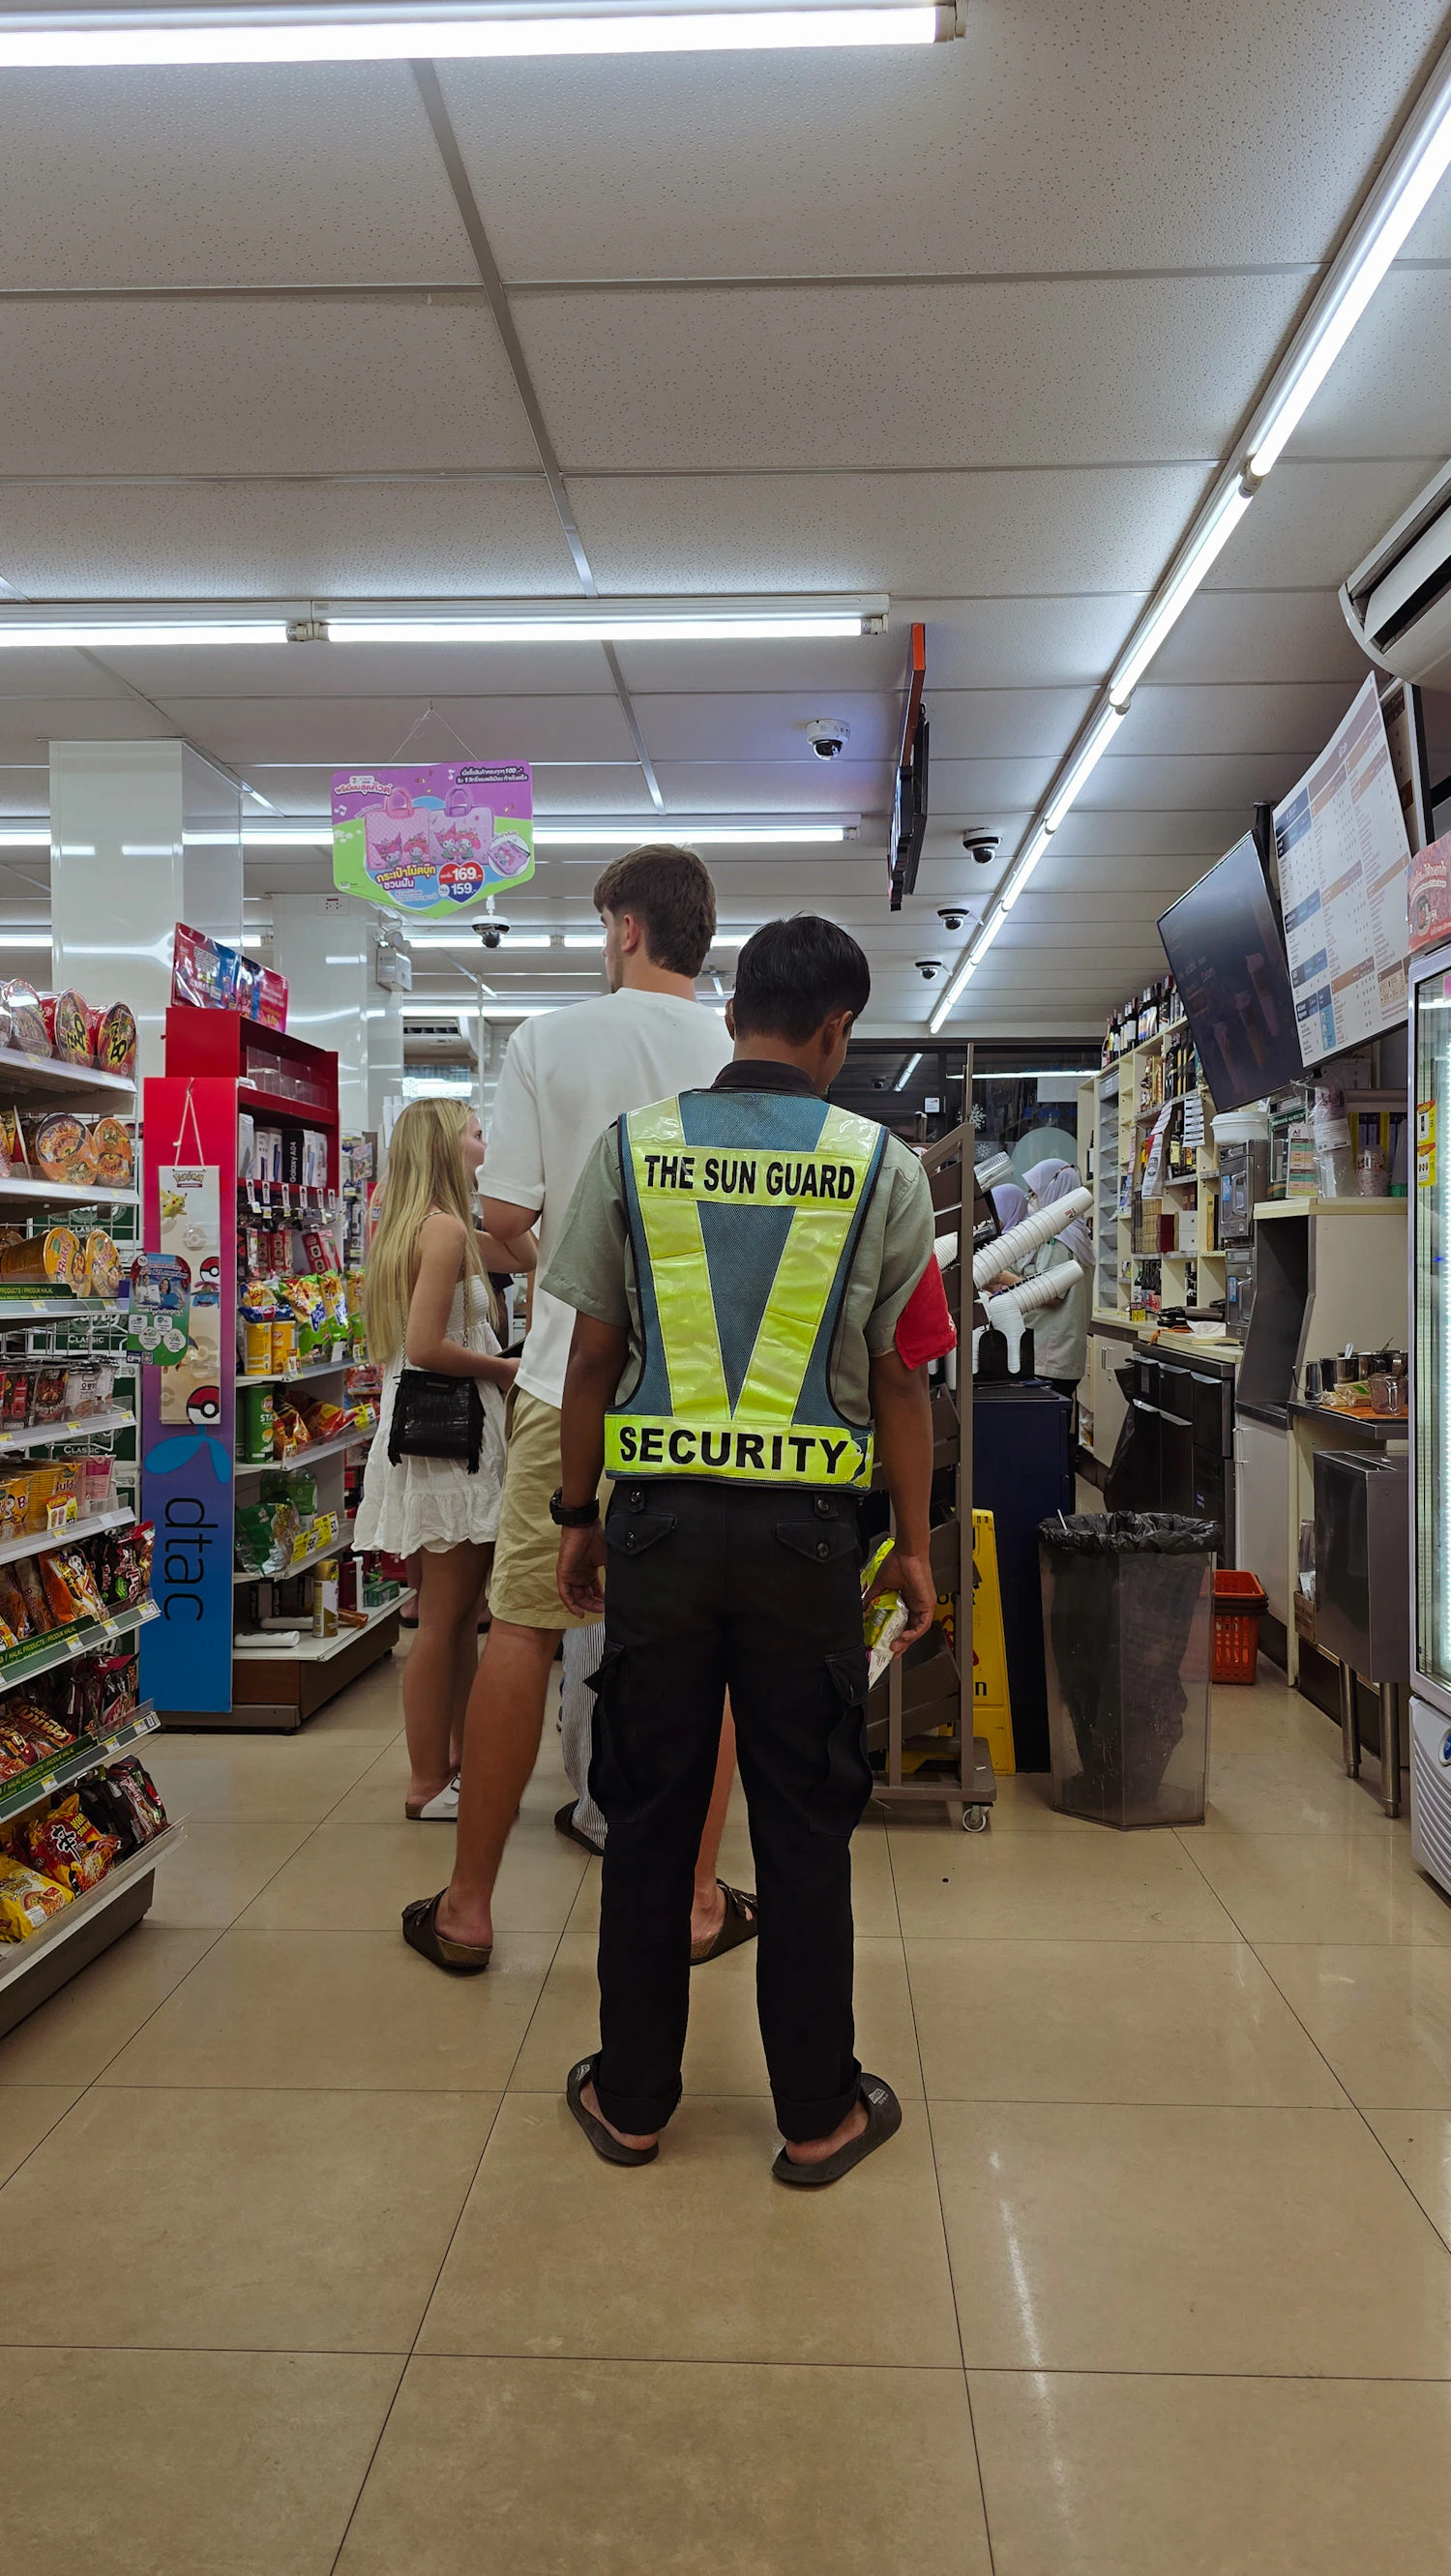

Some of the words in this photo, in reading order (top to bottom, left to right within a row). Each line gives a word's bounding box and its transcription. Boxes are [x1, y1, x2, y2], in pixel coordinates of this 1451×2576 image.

[289, 1156, 298, 1183] Galaxy
[643, 1154, 695, 1190] THE
[704, 1158, 756, 1196] SUN
[766, 1162, 856, 1200] GUARD
[619, 1425, 849, 1474] SECURITY
[163, 1497, 219, 1622] dtac
[22, 1637, 45, 1653] PRODUCTS
